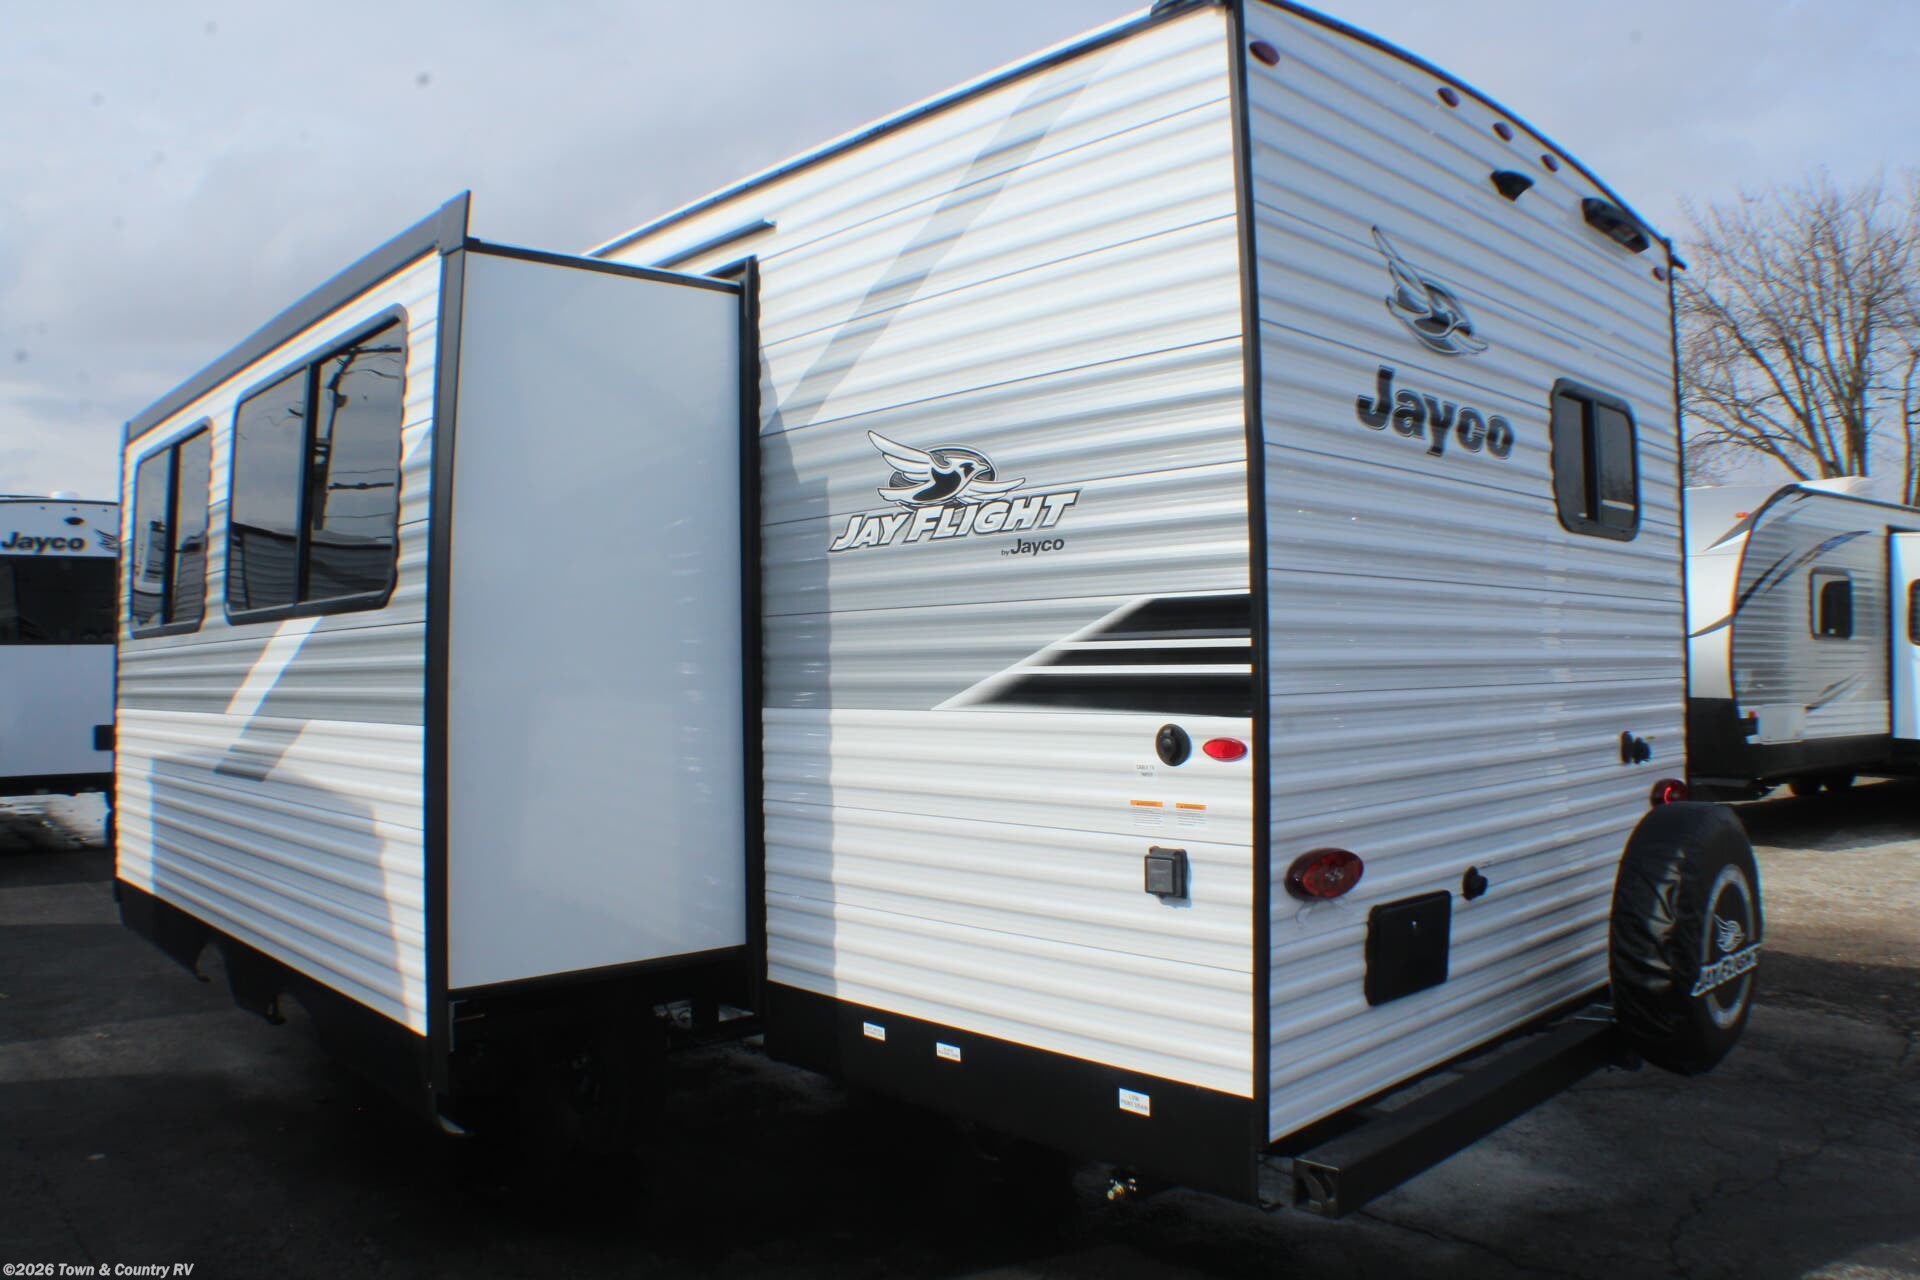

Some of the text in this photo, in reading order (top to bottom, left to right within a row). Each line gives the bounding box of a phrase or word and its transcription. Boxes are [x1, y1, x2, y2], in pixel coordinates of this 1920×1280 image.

[1356, 365, 1514, 459] Jayco
[0, 531, 86, 553] Jayco
[1010, 538, 1065, 556] Jayco
